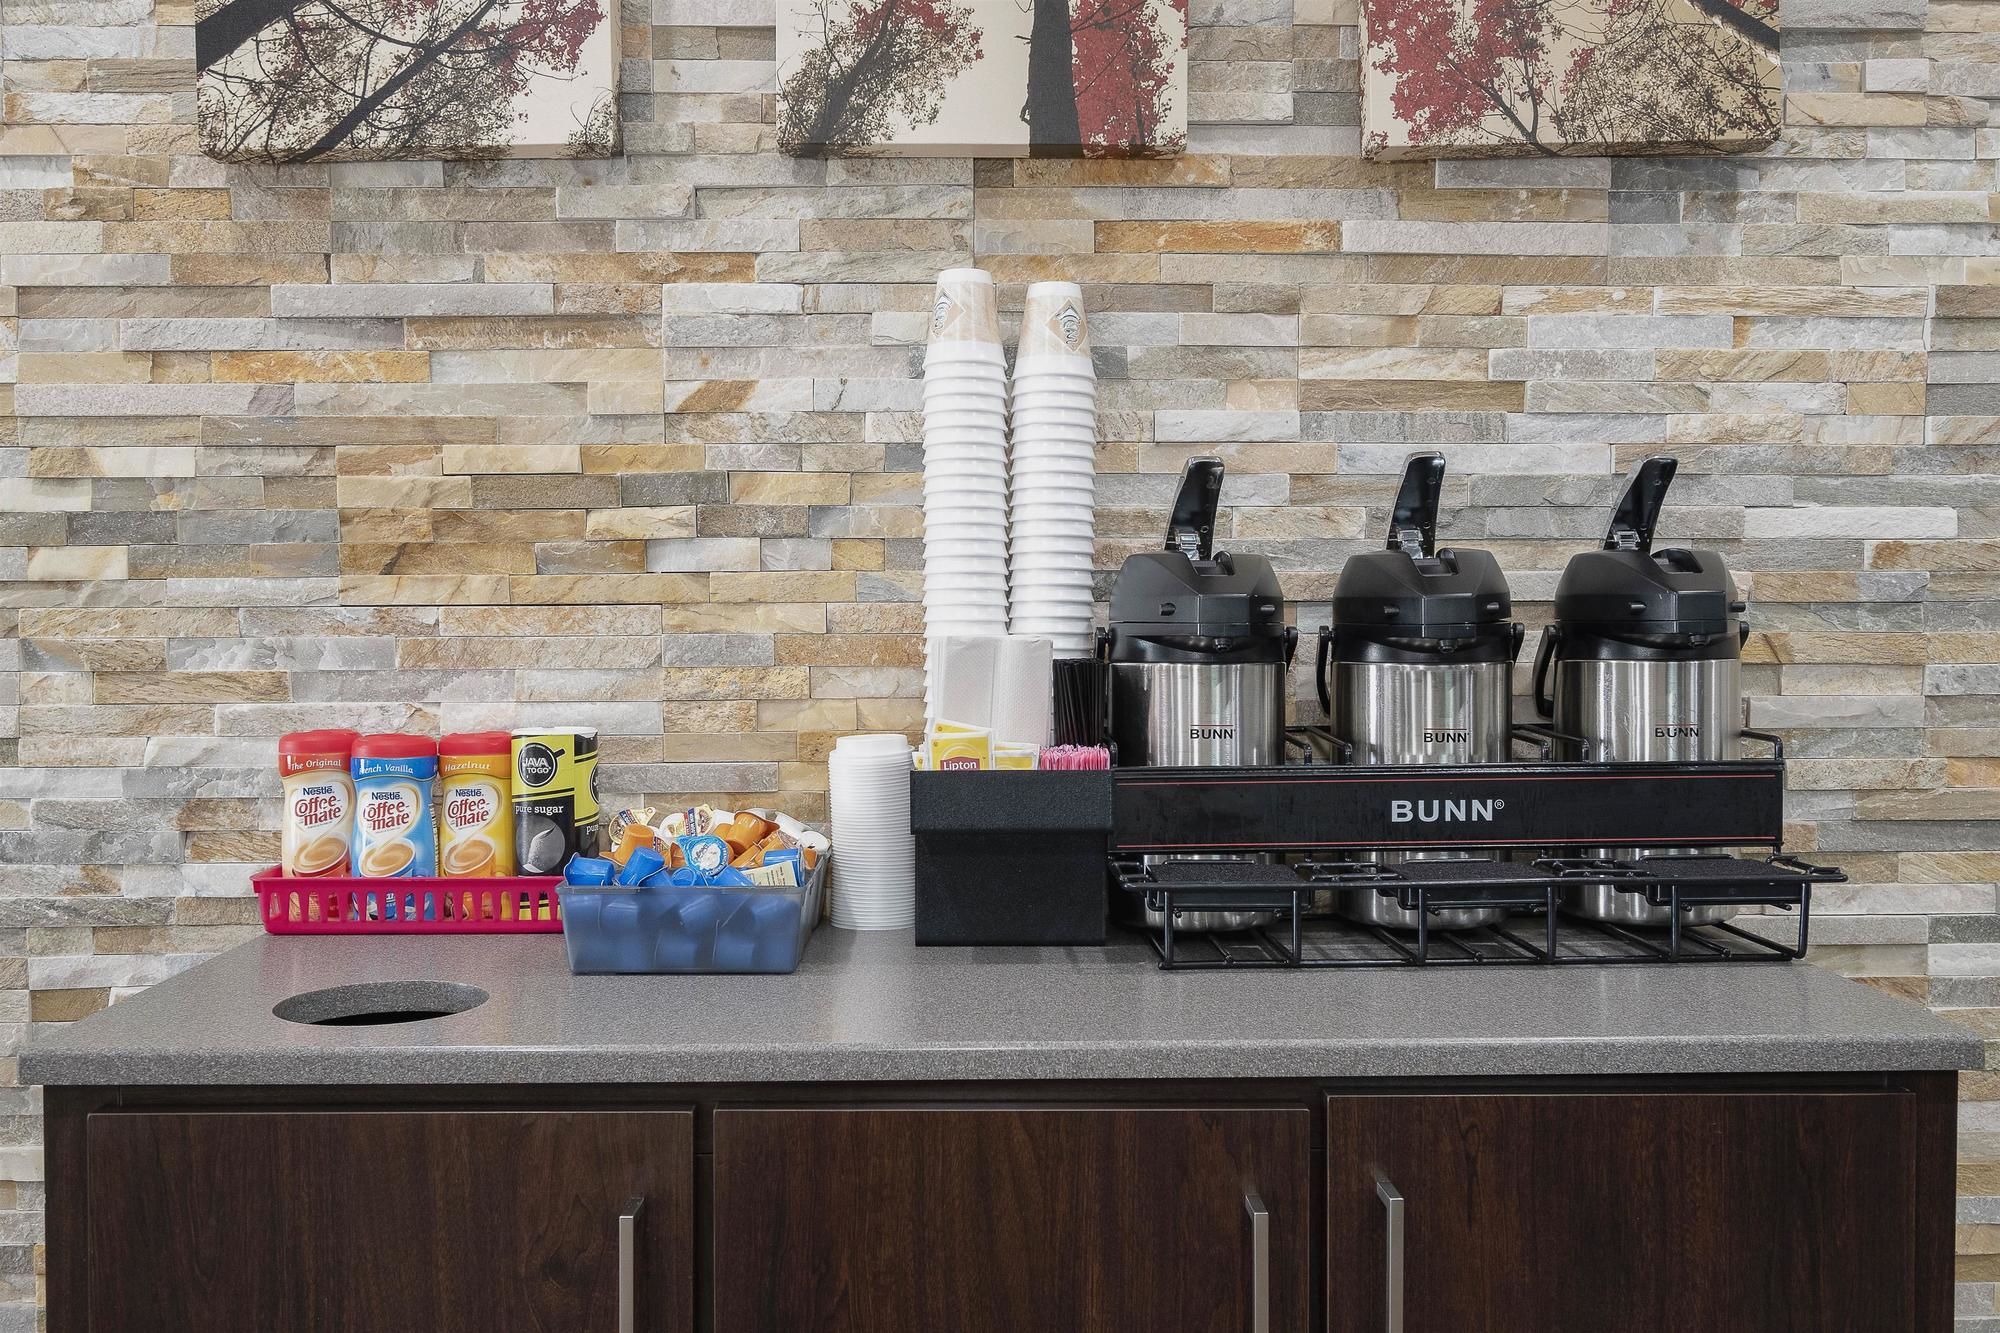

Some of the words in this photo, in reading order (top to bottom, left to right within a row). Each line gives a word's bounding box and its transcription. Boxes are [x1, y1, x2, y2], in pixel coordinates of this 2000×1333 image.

[1190, 728, 1232, 739] BUNN
[1423, 732, 1466, 743] BUNN
[1654, 727, 1699, 737] BUNN
[291, 762, 303, 771] The
[305, 759, 341, 768] Original
[444, 760, 490, 772] Hazelnut
[523, 757, 549, 768] JAVA
[943, 761, 977, 771] Lipton
[359, 763, 381, 775] ench
[385, 763, 414, 774] Vanilla
[303, 806, 341, 826] mate
[515, 805, 532, 815] pure
[534, 805, 564, 816] sugar
[372, 812, 410, 831] mate
[455, 810, 489, 827] mate
[586, 824, 599, 835] pur
